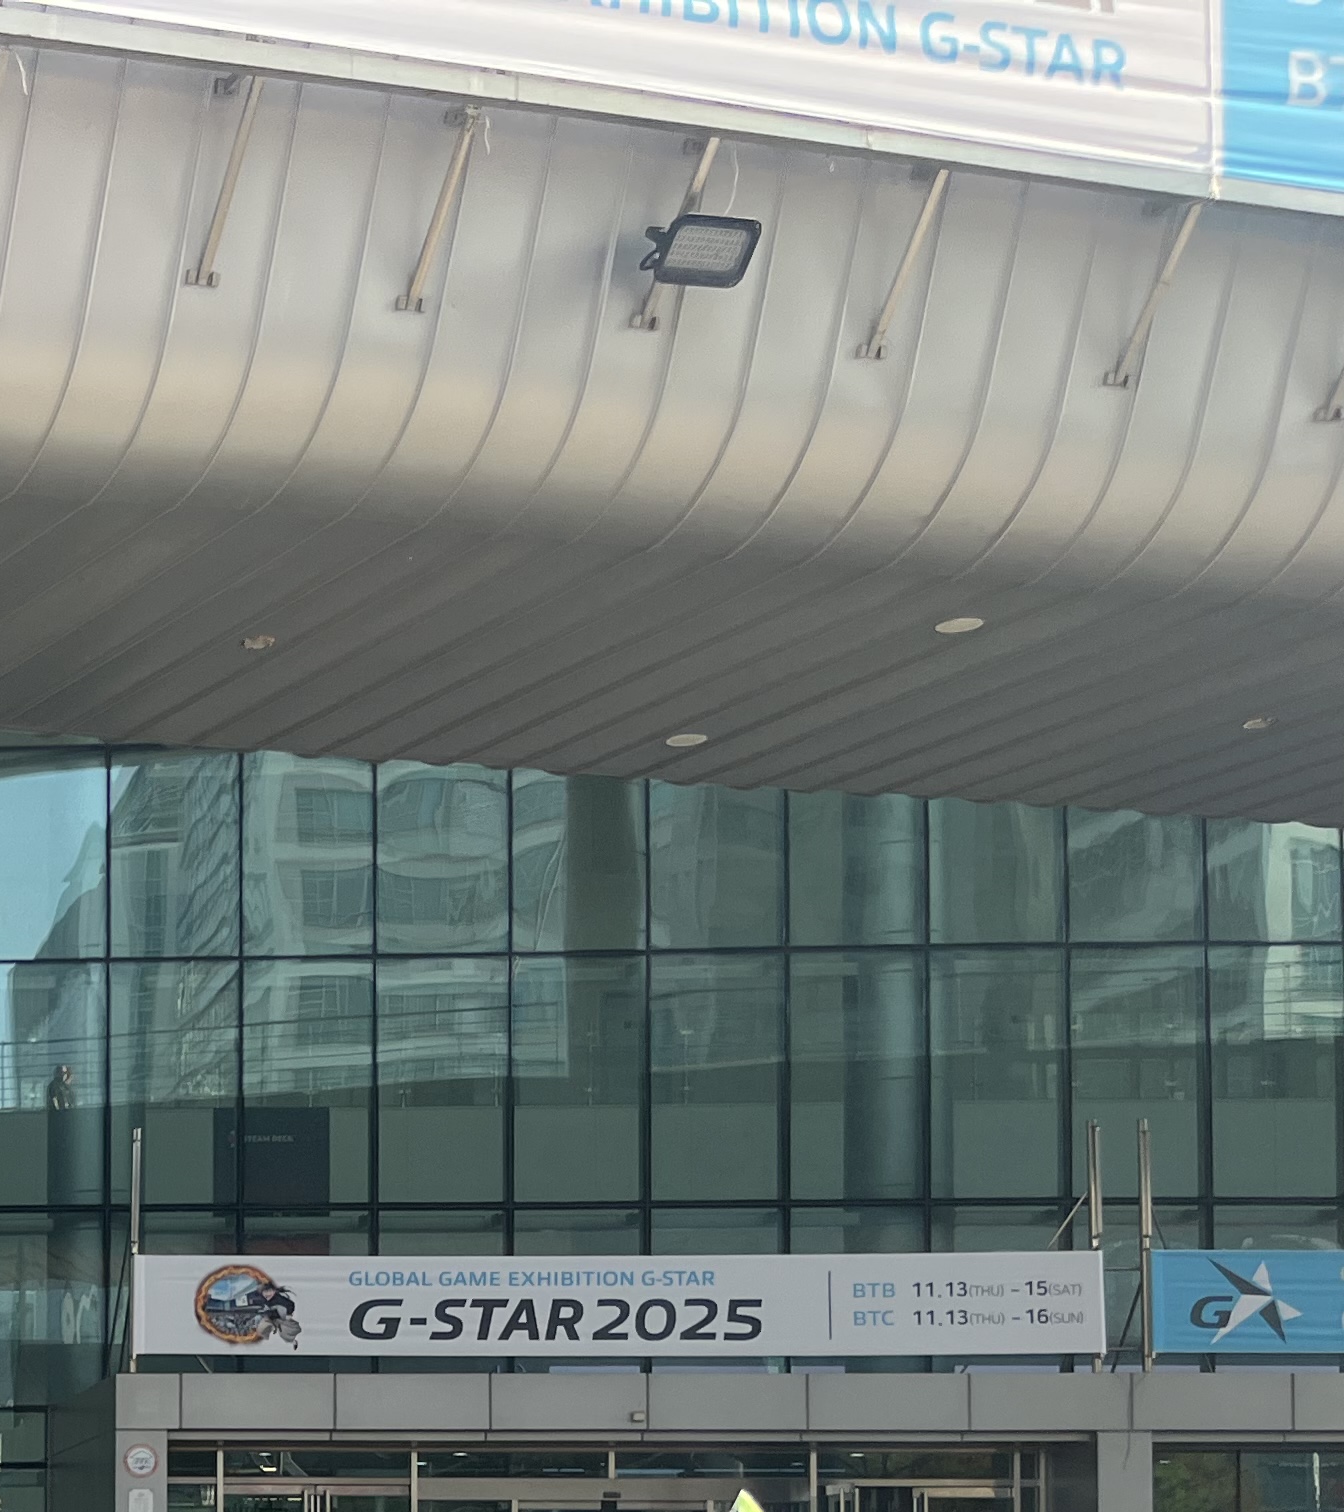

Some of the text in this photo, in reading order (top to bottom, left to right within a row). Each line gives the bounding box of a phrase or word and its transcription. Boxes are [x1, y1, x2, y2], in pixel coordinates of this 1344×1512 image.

[919, 10, 1127, 88] G-STAR
[1287, 48, 1344, 107] B
[348, 1270, 715, 1287] GLOBAL GAME EXHIBITION G-STAR
[852, 1282, 896, 1298] BTB
[913, 1280, 1005, 1299] 11.13(THU)
[1024, 1280, 1083, 1297] 15(SAT)
[852, 1310, 896, 1327] BTC
[913, 1309, 1005, 1328] 11.13(THU)
[1024, 1308, 1084, 1326] 16(SUN)
